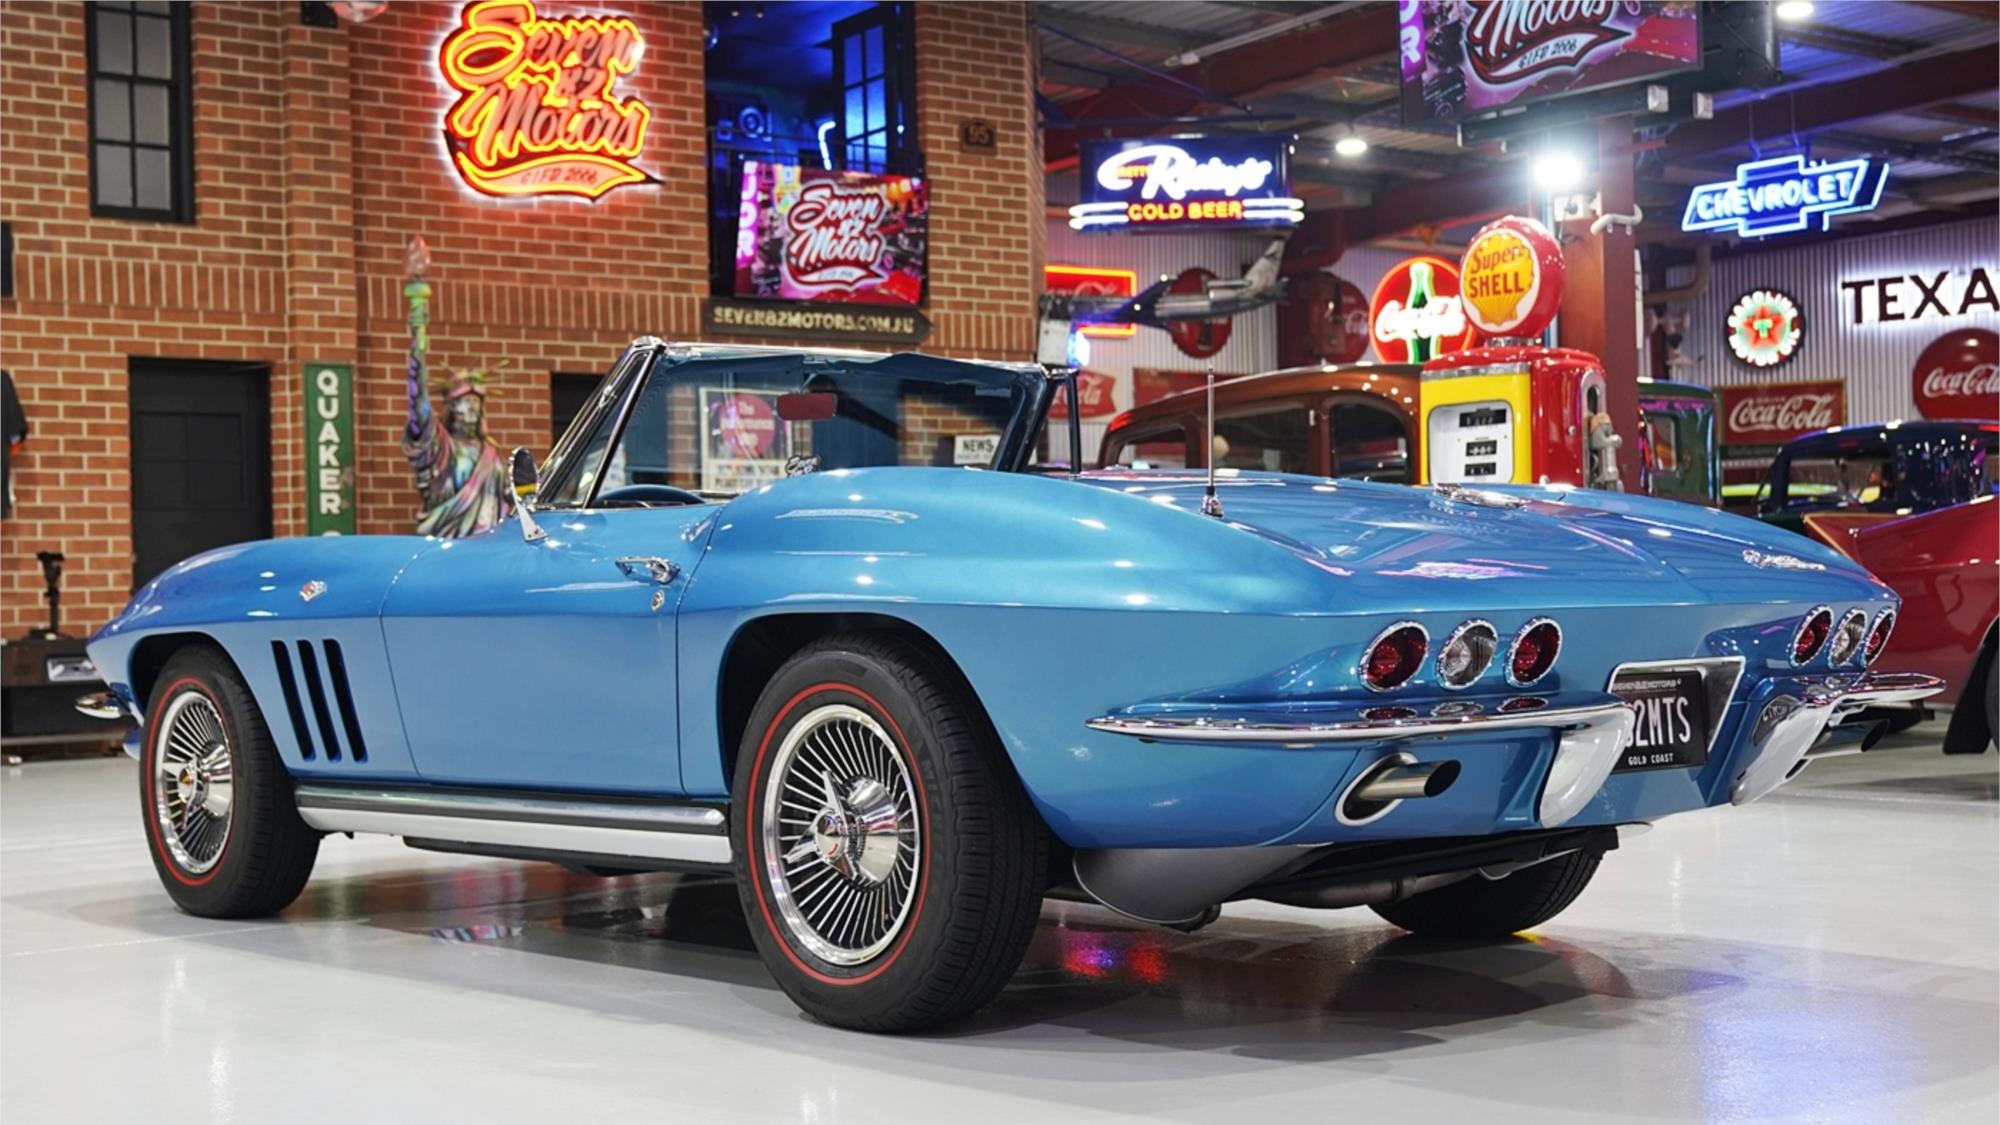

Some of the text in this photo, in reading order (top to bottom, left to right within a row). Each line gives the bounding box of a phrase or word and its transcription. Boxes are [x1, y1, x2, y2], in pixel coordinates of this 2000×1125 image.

[446, 1, 643, 87] Seven
[557, 66, 606, 101] 82
[457, 81, 643, 164] Motors
[968, 125, 990, 145] 95
[790, 185, 880, 230] Seven
[1128, 200, 1243, 221] COLD BEER
[1697, 172, 1853, 220] CHEVROLET
[789, 227, 880, 268] Motors
[1469, 272, 1525, 299] SHELL
[1842, 268, 1999, 324] TEXA
[1729, 393, 1834, 432] Coca-Cola
[316, 369, 341, 515] QUAKER
[962, 439, 994, 453] NEWS
[1625, 696, 1691, 747] 2MTS
[1628, 752, 1673, 766] GOLD COAST
